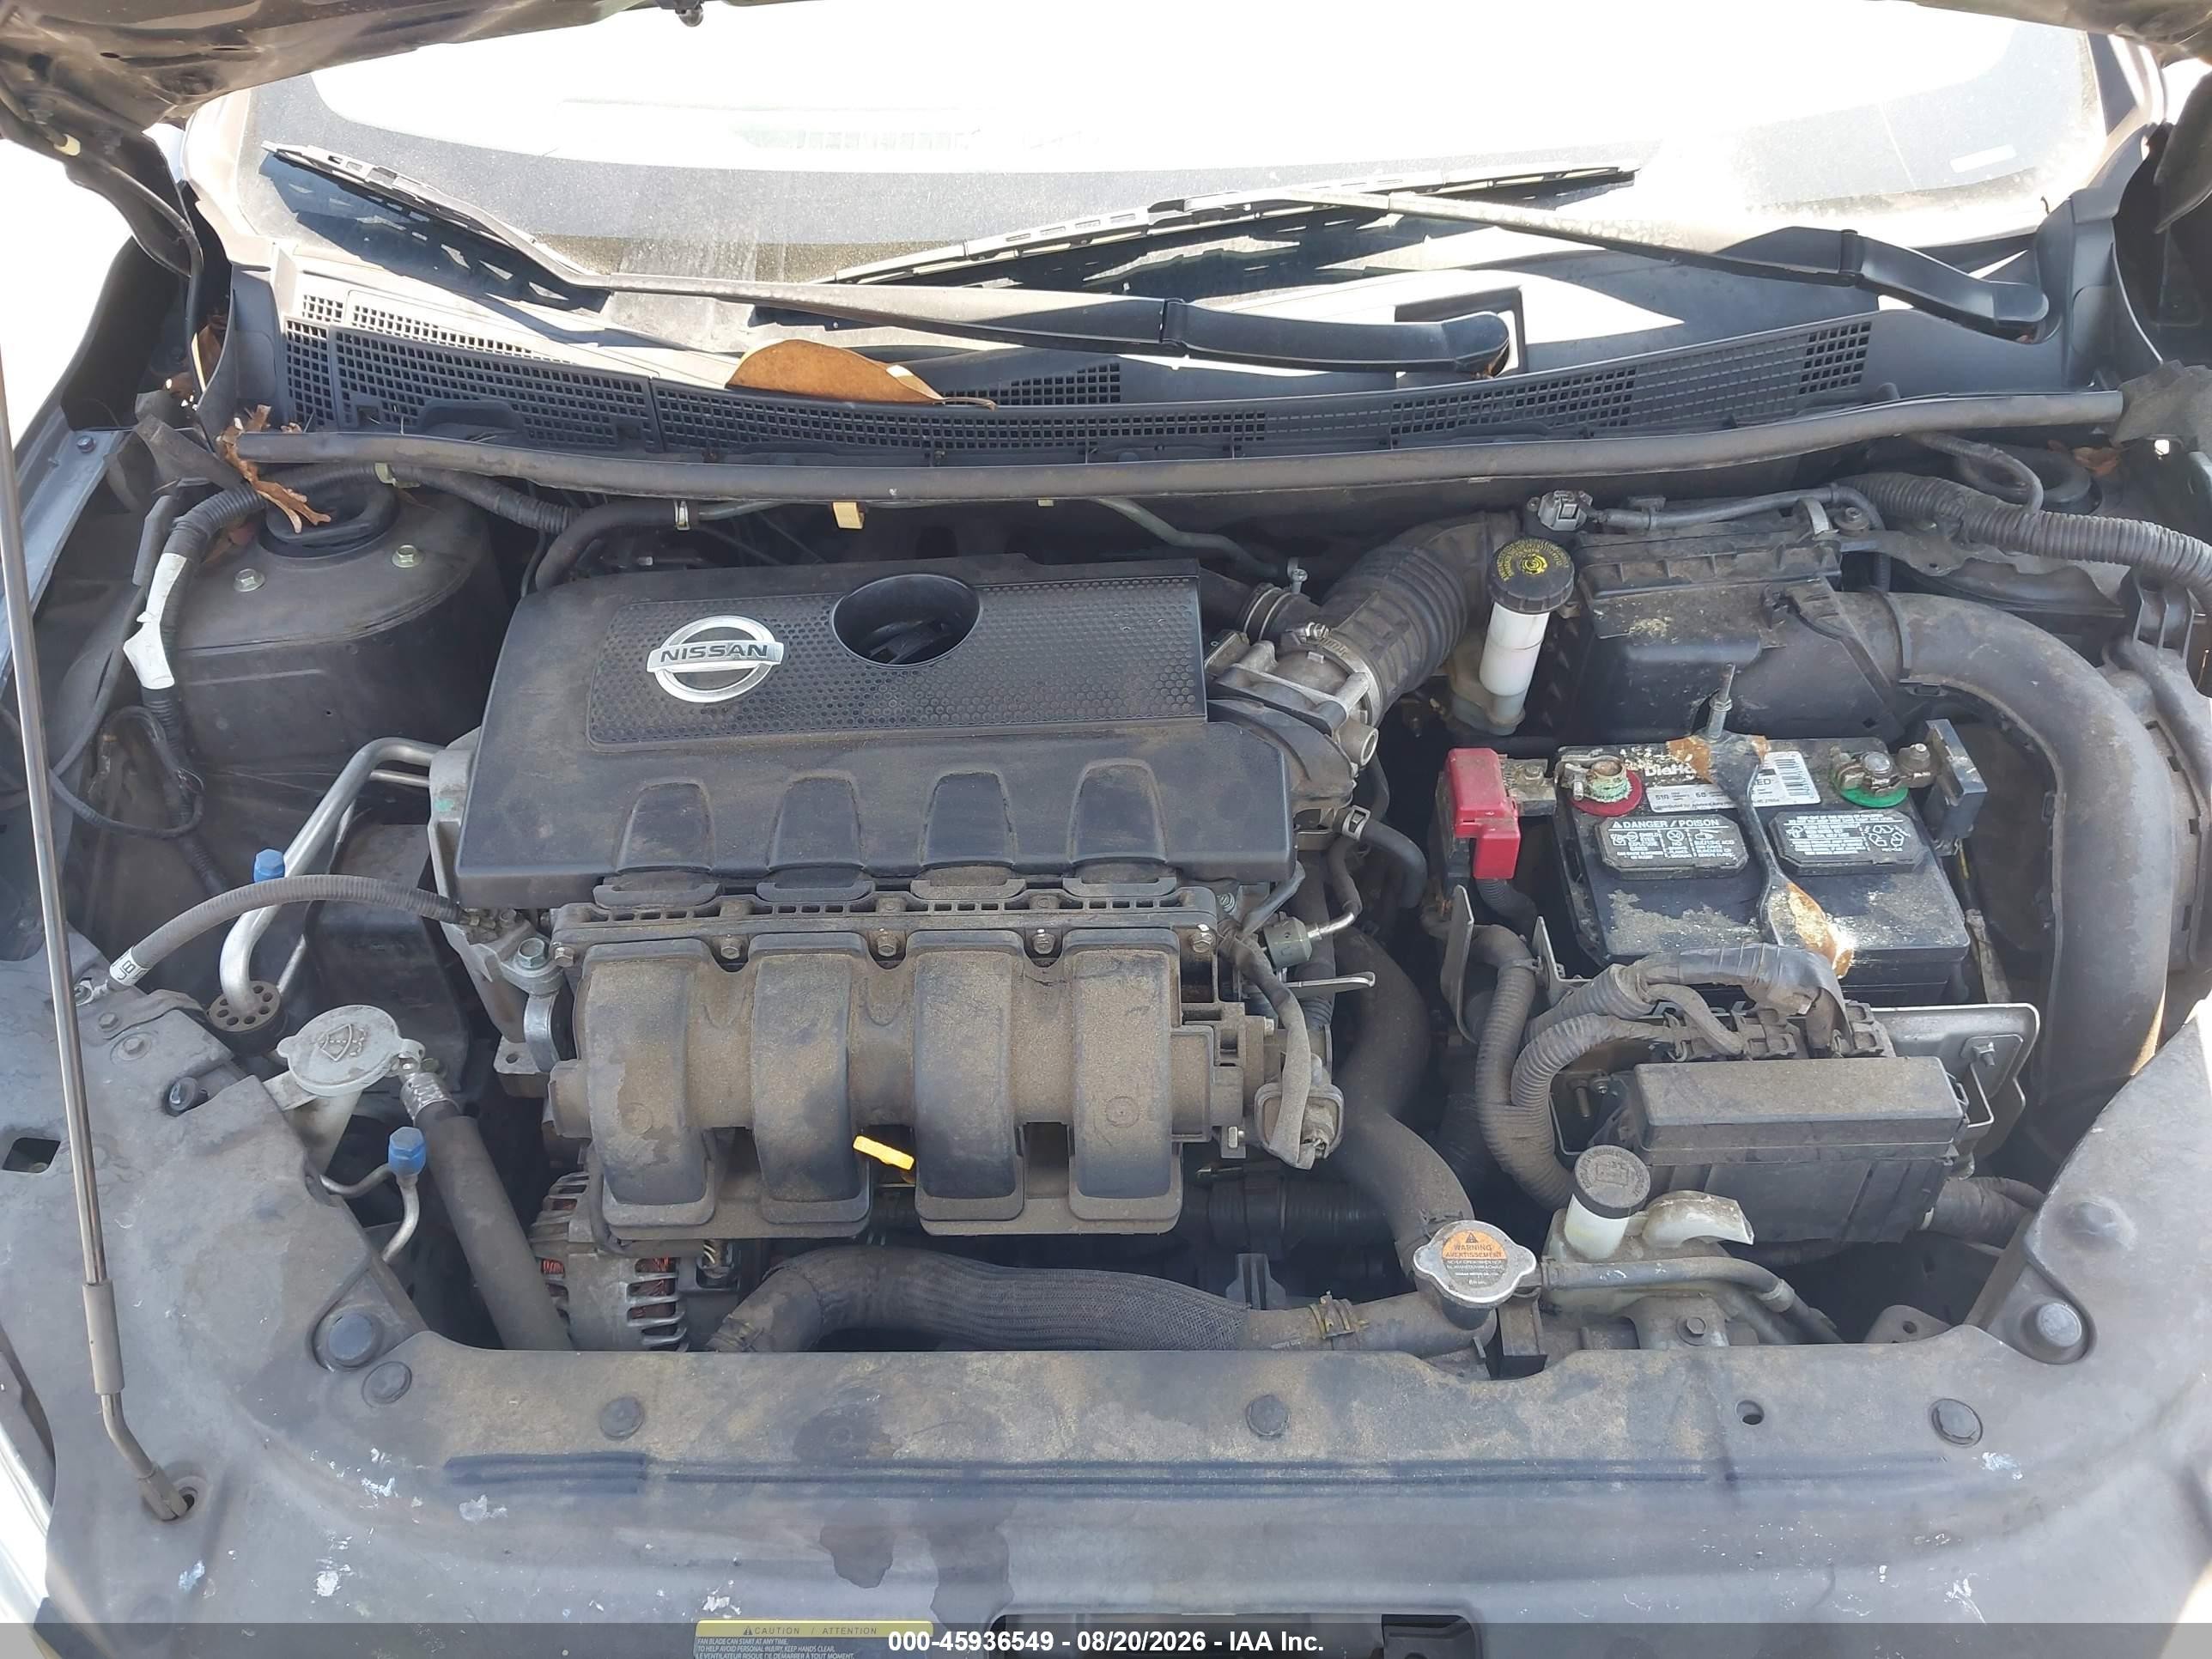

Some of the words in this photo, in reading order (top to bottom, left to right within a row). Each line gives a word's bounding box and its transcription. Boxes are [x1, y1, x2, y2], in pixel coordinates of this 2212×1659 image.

[660, 645, 768, 663] NISSAN
[1622, 820, 1668, 829] DANGER
[1679, 819, 1720, 828] POISON
[822, 1626, 878, 1635] ATTENTION
